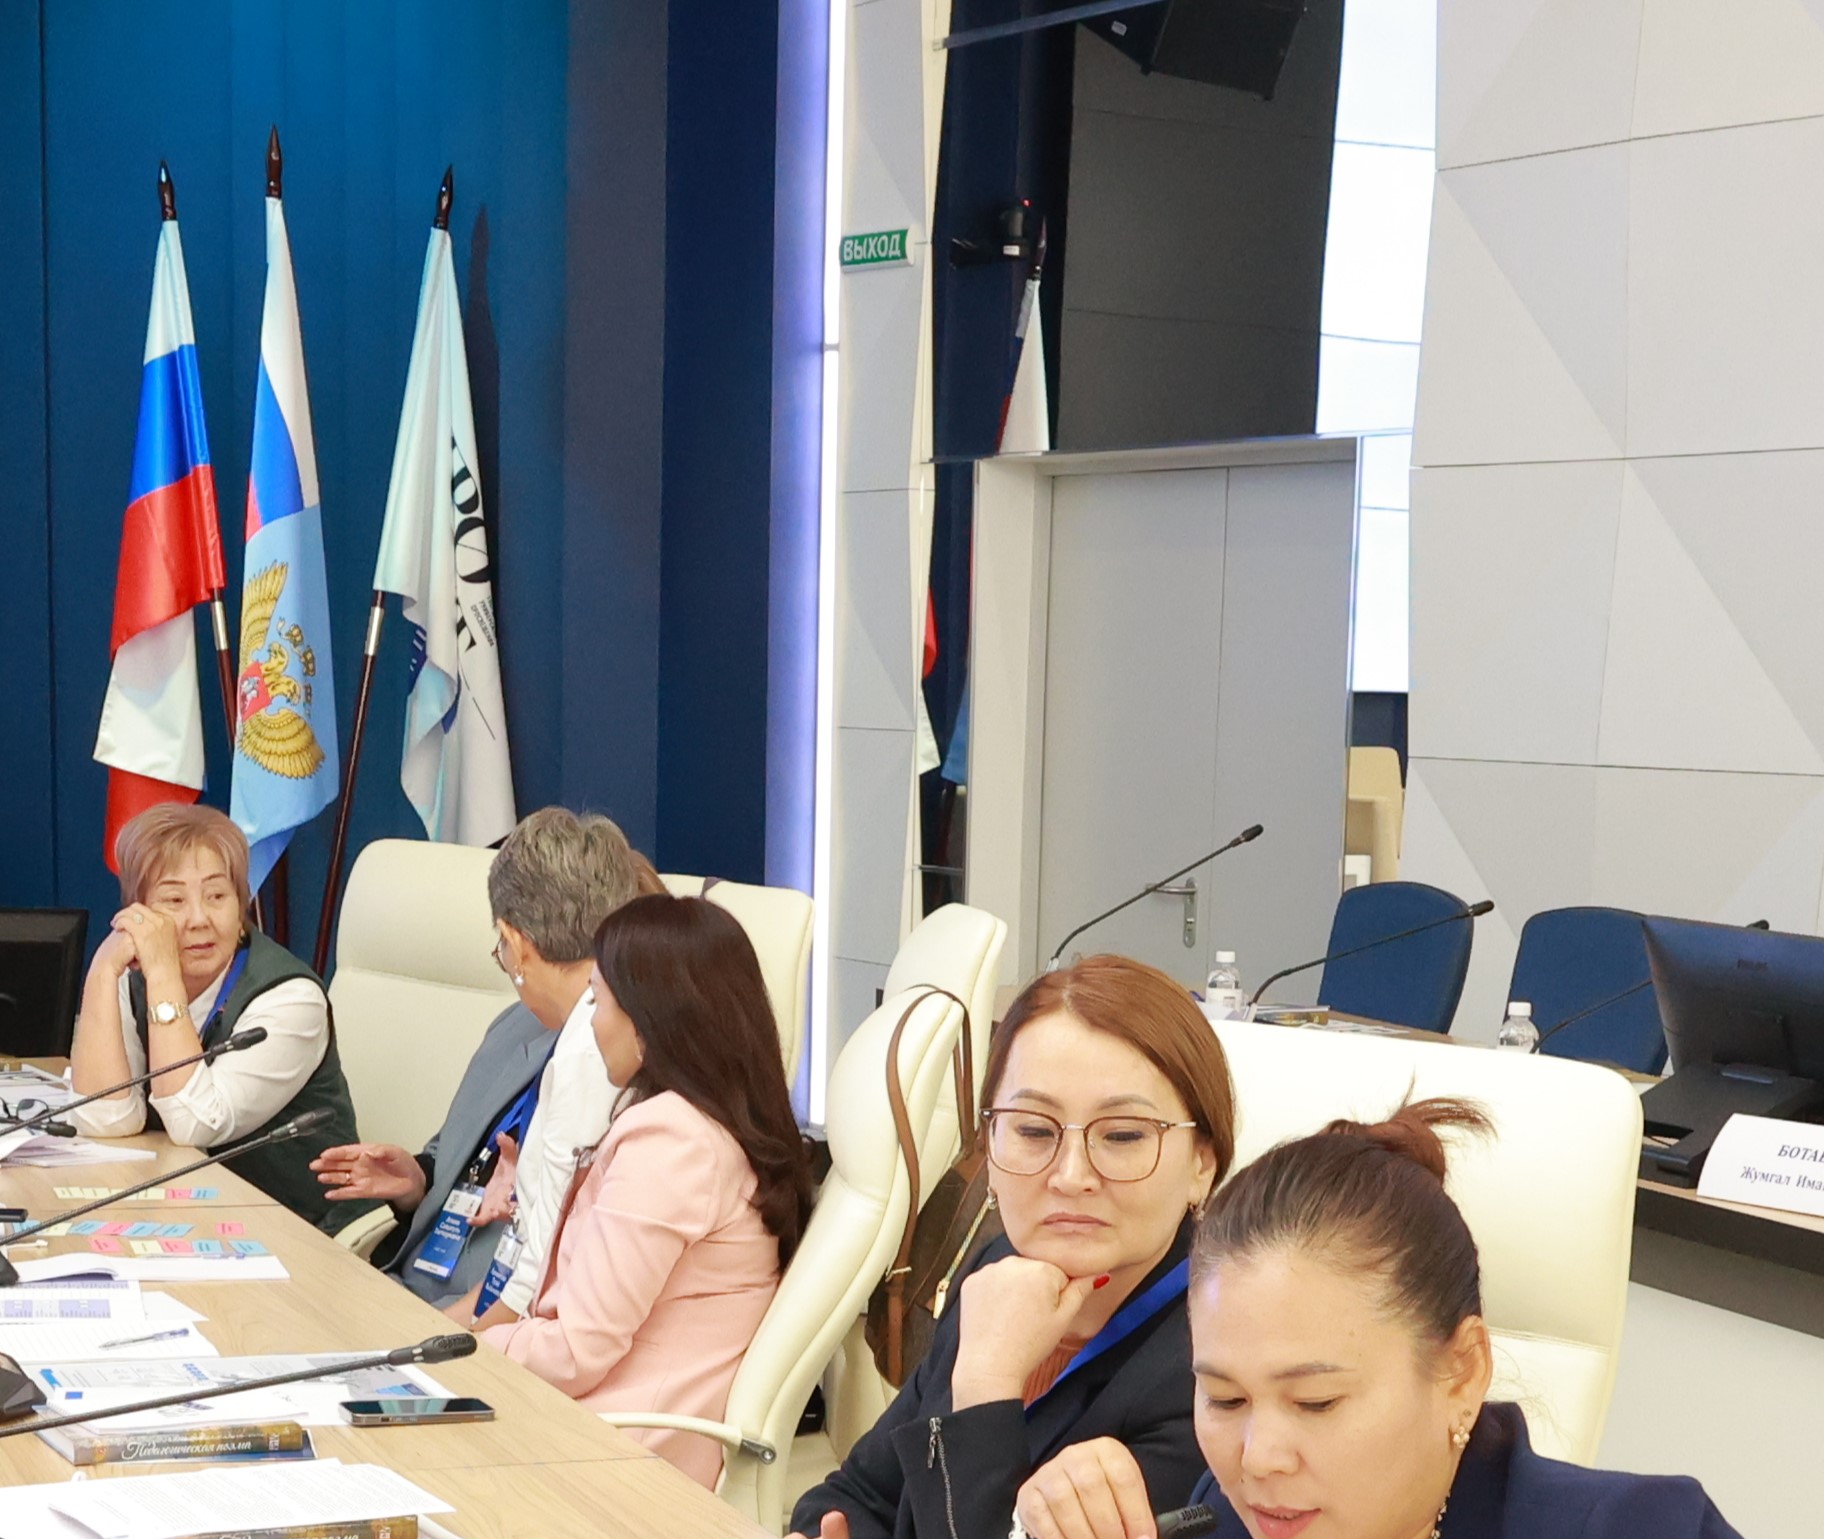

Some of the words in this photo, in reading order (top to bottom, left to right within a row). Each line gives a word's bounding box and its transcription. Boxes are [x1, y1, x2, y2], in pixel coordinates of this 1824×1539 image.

[843, 232, 902, 262] ВЫХОД
[1739, 1166, 1792, 1188] Жумгал
[121, 1439, 215, 1460] Педагогическая
[219, 1441, 252, 1453] поэма
